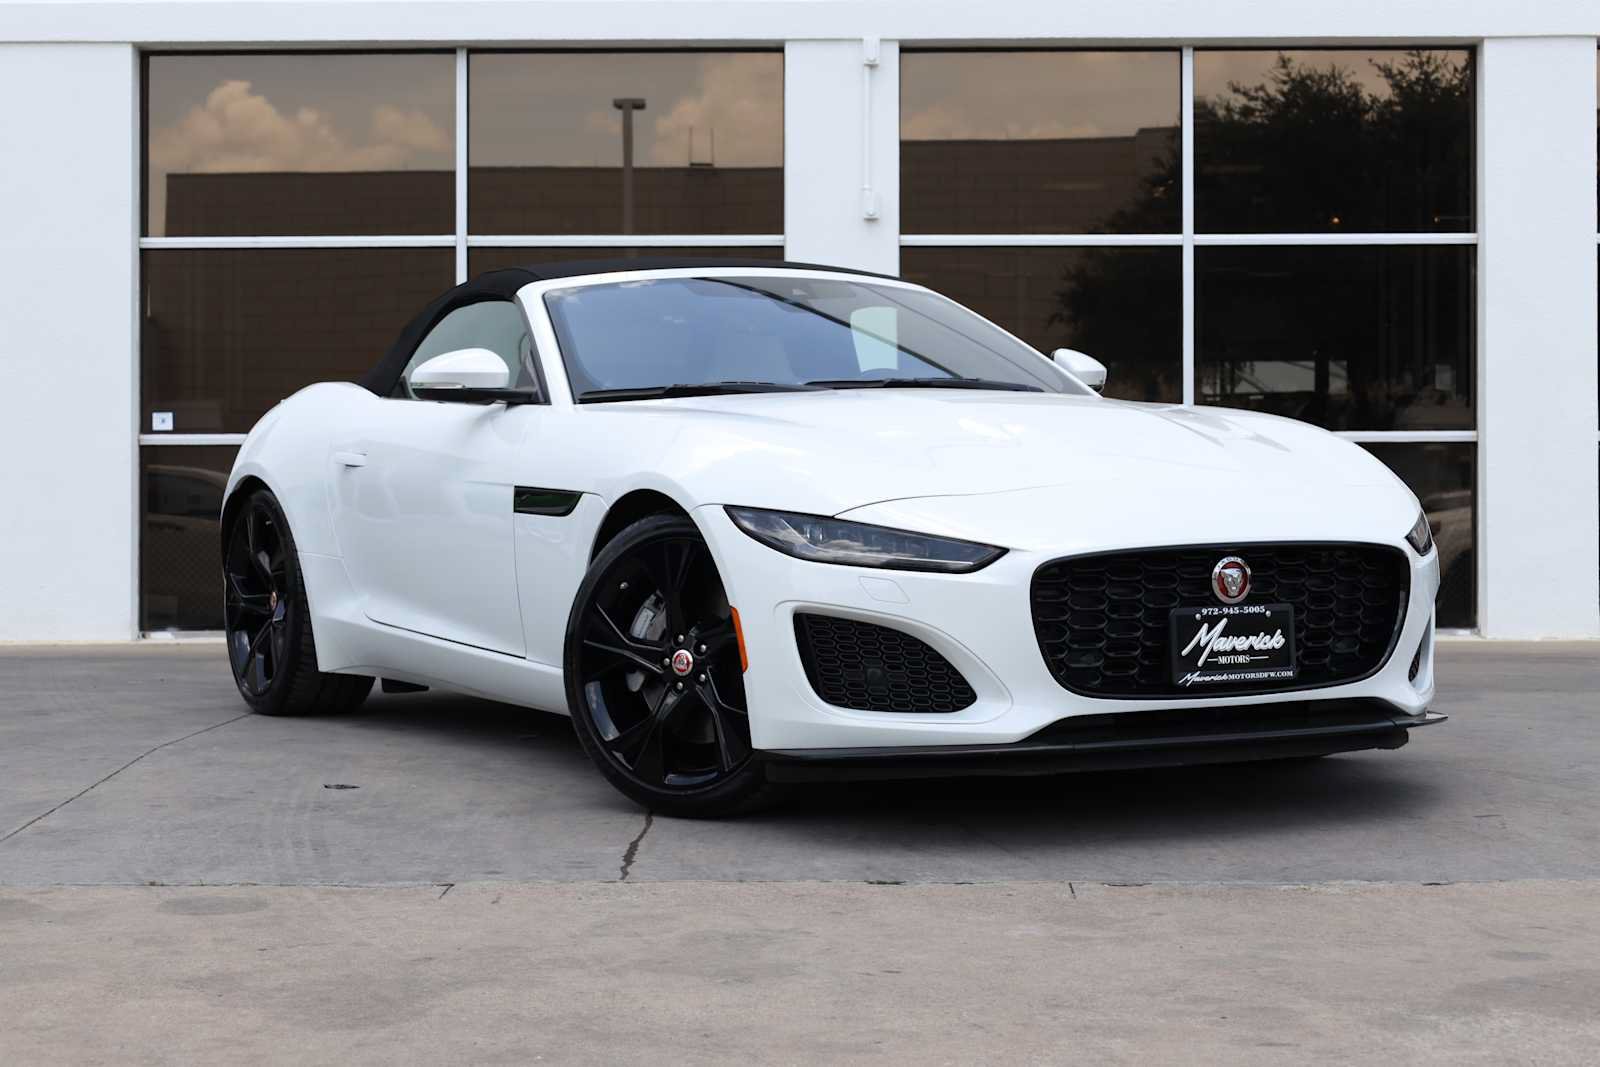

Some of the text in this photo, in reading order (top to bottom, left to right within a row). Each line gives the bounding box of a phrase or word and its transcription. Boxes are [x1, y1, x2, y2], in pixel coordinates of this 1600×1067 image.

[1201, 605, 1265, 616] 972-945-5005
[1181, 617, 1286, 667] Maverick
[1217, 654, 1251, 665] MOTORS
